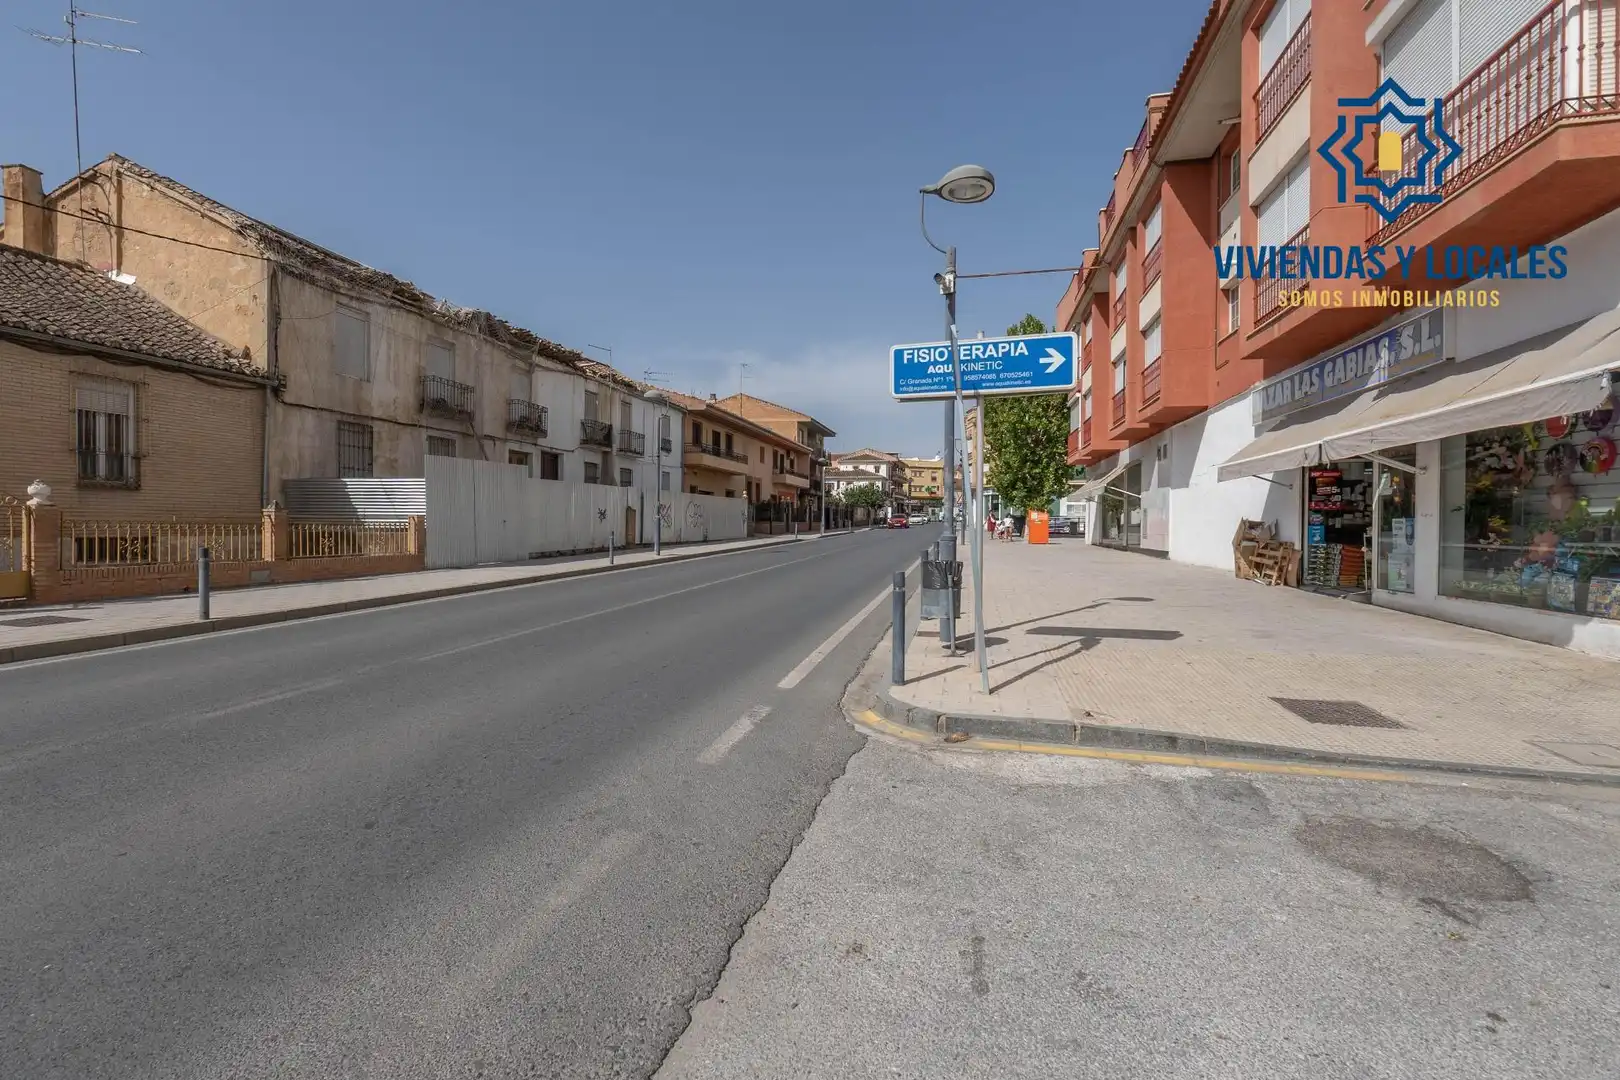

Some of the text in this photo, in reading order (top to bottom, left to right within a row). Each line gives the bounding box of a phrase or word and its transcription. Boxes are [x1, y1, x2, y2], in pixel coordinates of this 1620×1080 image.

[907, 377, 932, 385] Granada
[1254, 379, 1290, 411] AZAR
[1294, 367, 1321, 400] LAS
[1400, 316, 1441, 360] S.L.
